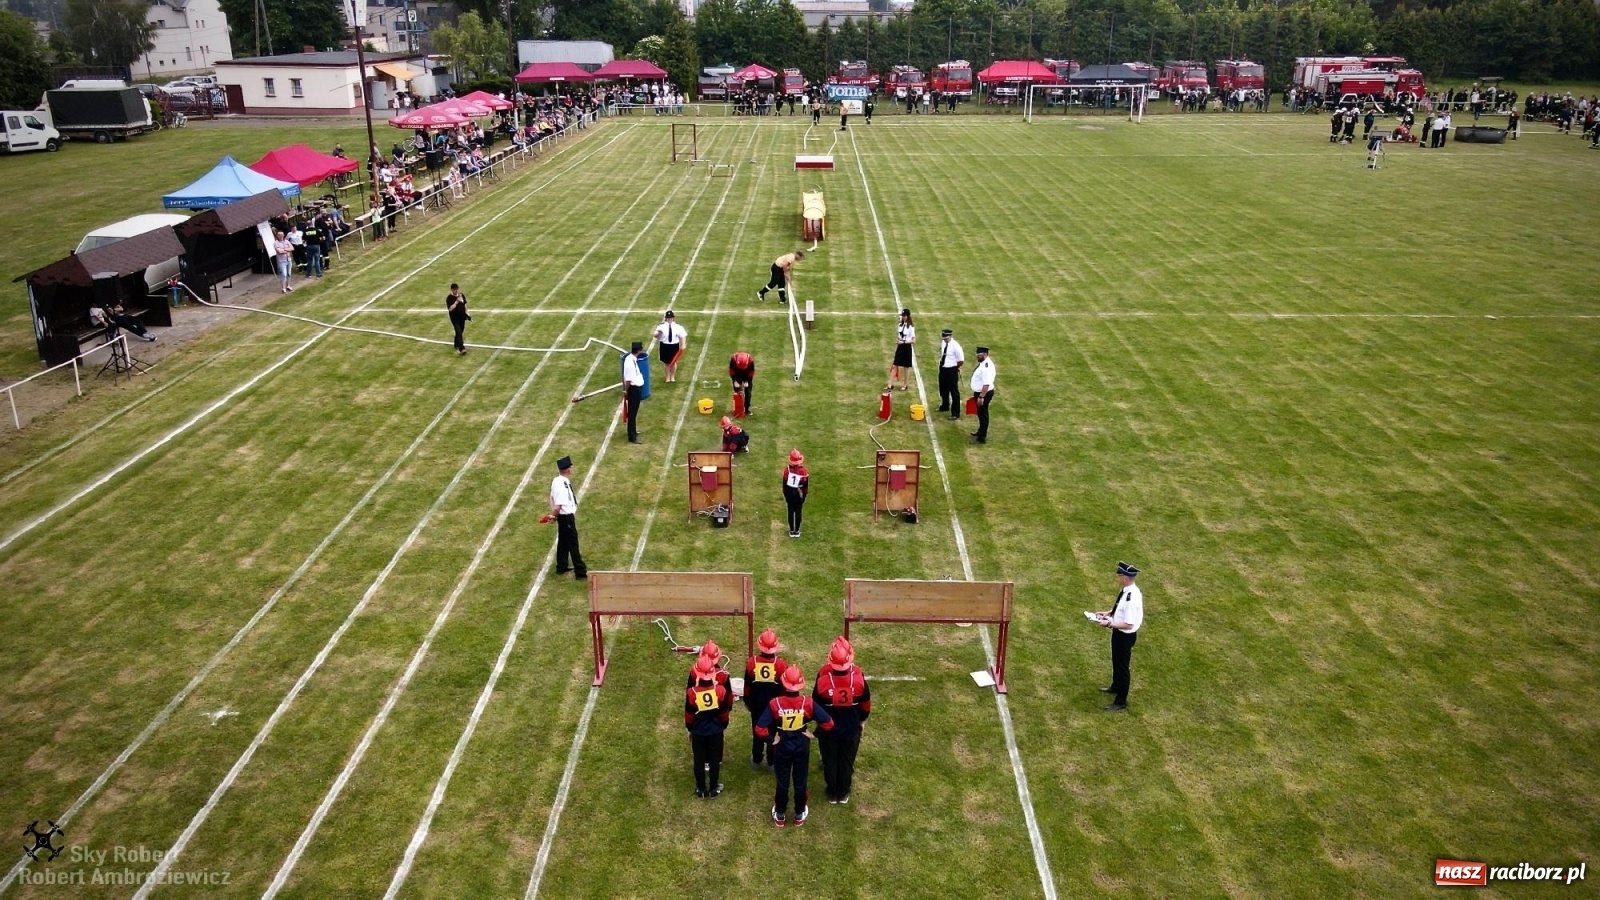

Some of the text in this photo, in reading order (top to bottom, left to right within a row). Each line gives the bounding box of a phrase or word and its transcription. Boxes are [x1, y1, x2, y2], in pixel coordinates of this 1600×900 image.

[791, 475, 796, 485] 1
[760, 665, 770, 679] 6
[702, 692, 713, 707] 9
[838, 689, 848, 704] 3
[786, 716, 797, 729] 7
